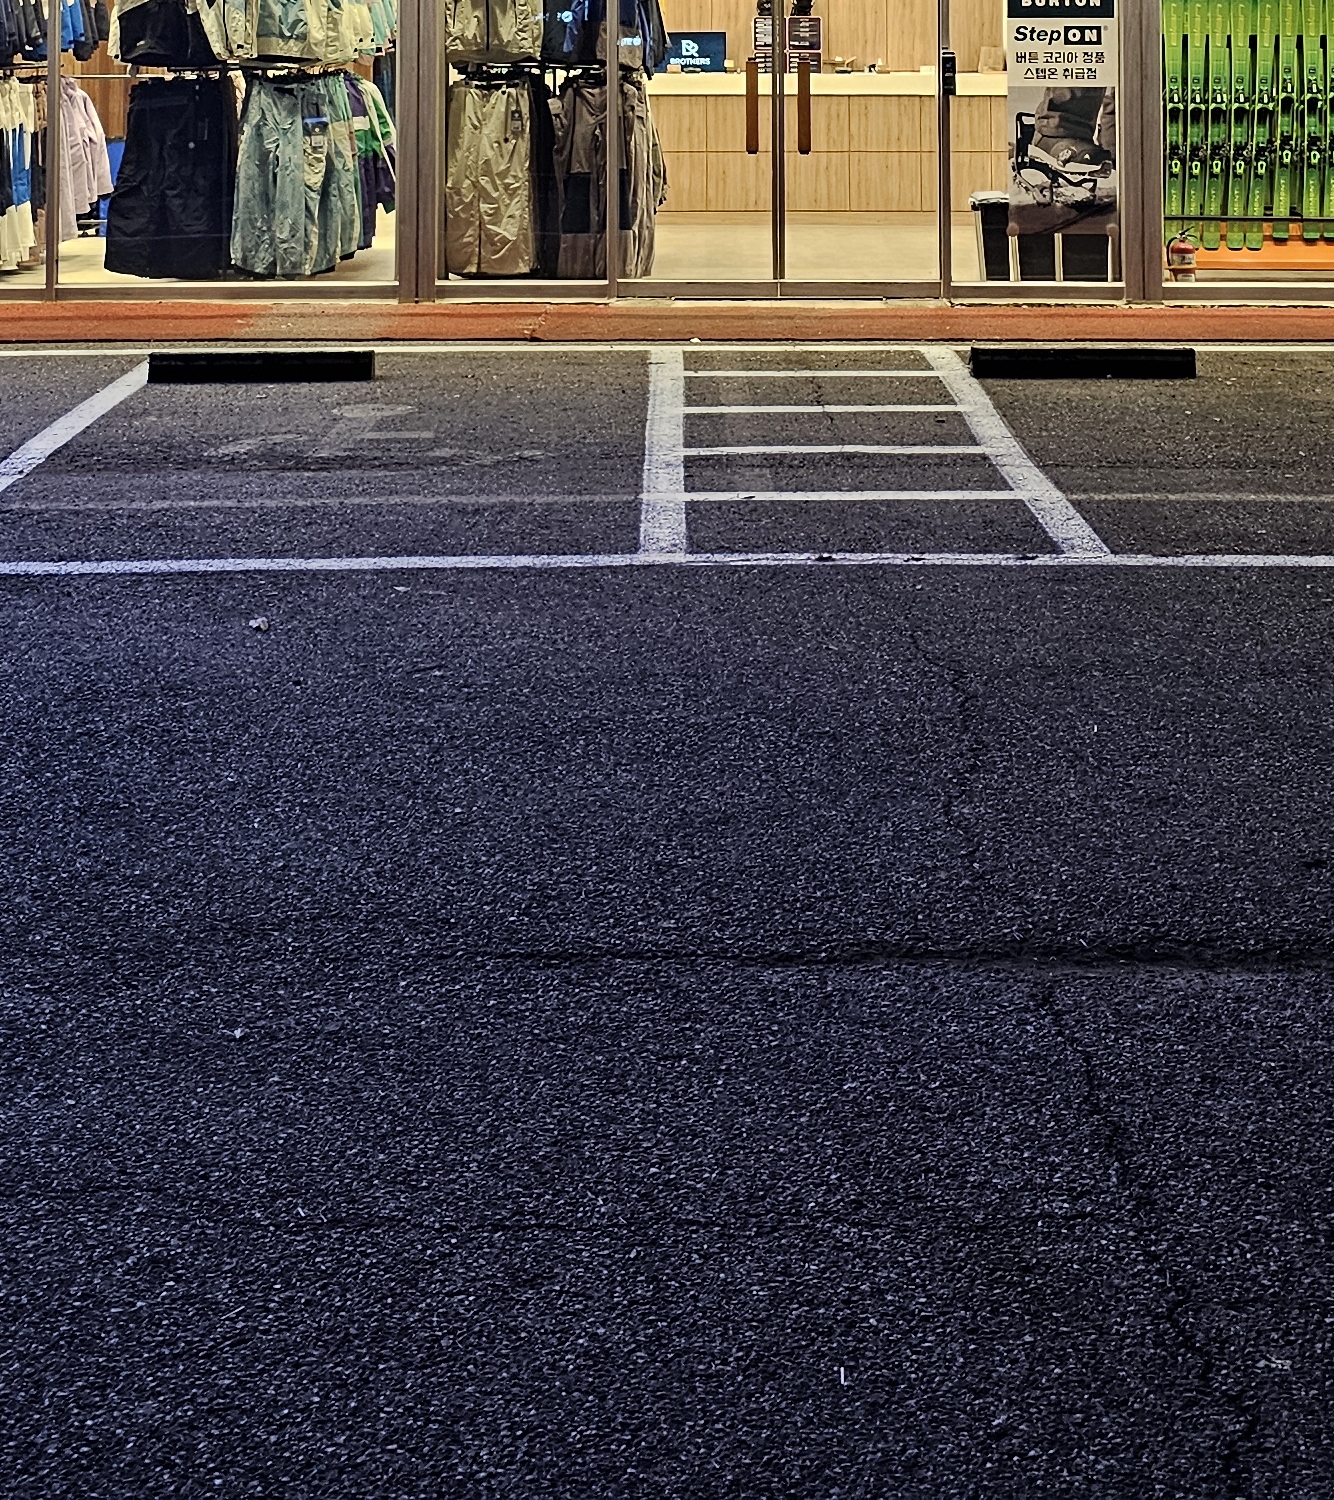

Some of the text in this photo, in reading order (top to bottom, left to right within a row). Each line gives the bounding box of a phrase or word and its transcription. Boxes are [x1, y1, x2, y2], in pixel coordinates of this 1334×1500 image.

[1014, 25, 1098, 45] Step ON
[1043, 51, 1078, 64] 코리아
[1062, 67, 1097, 80] 취급점
